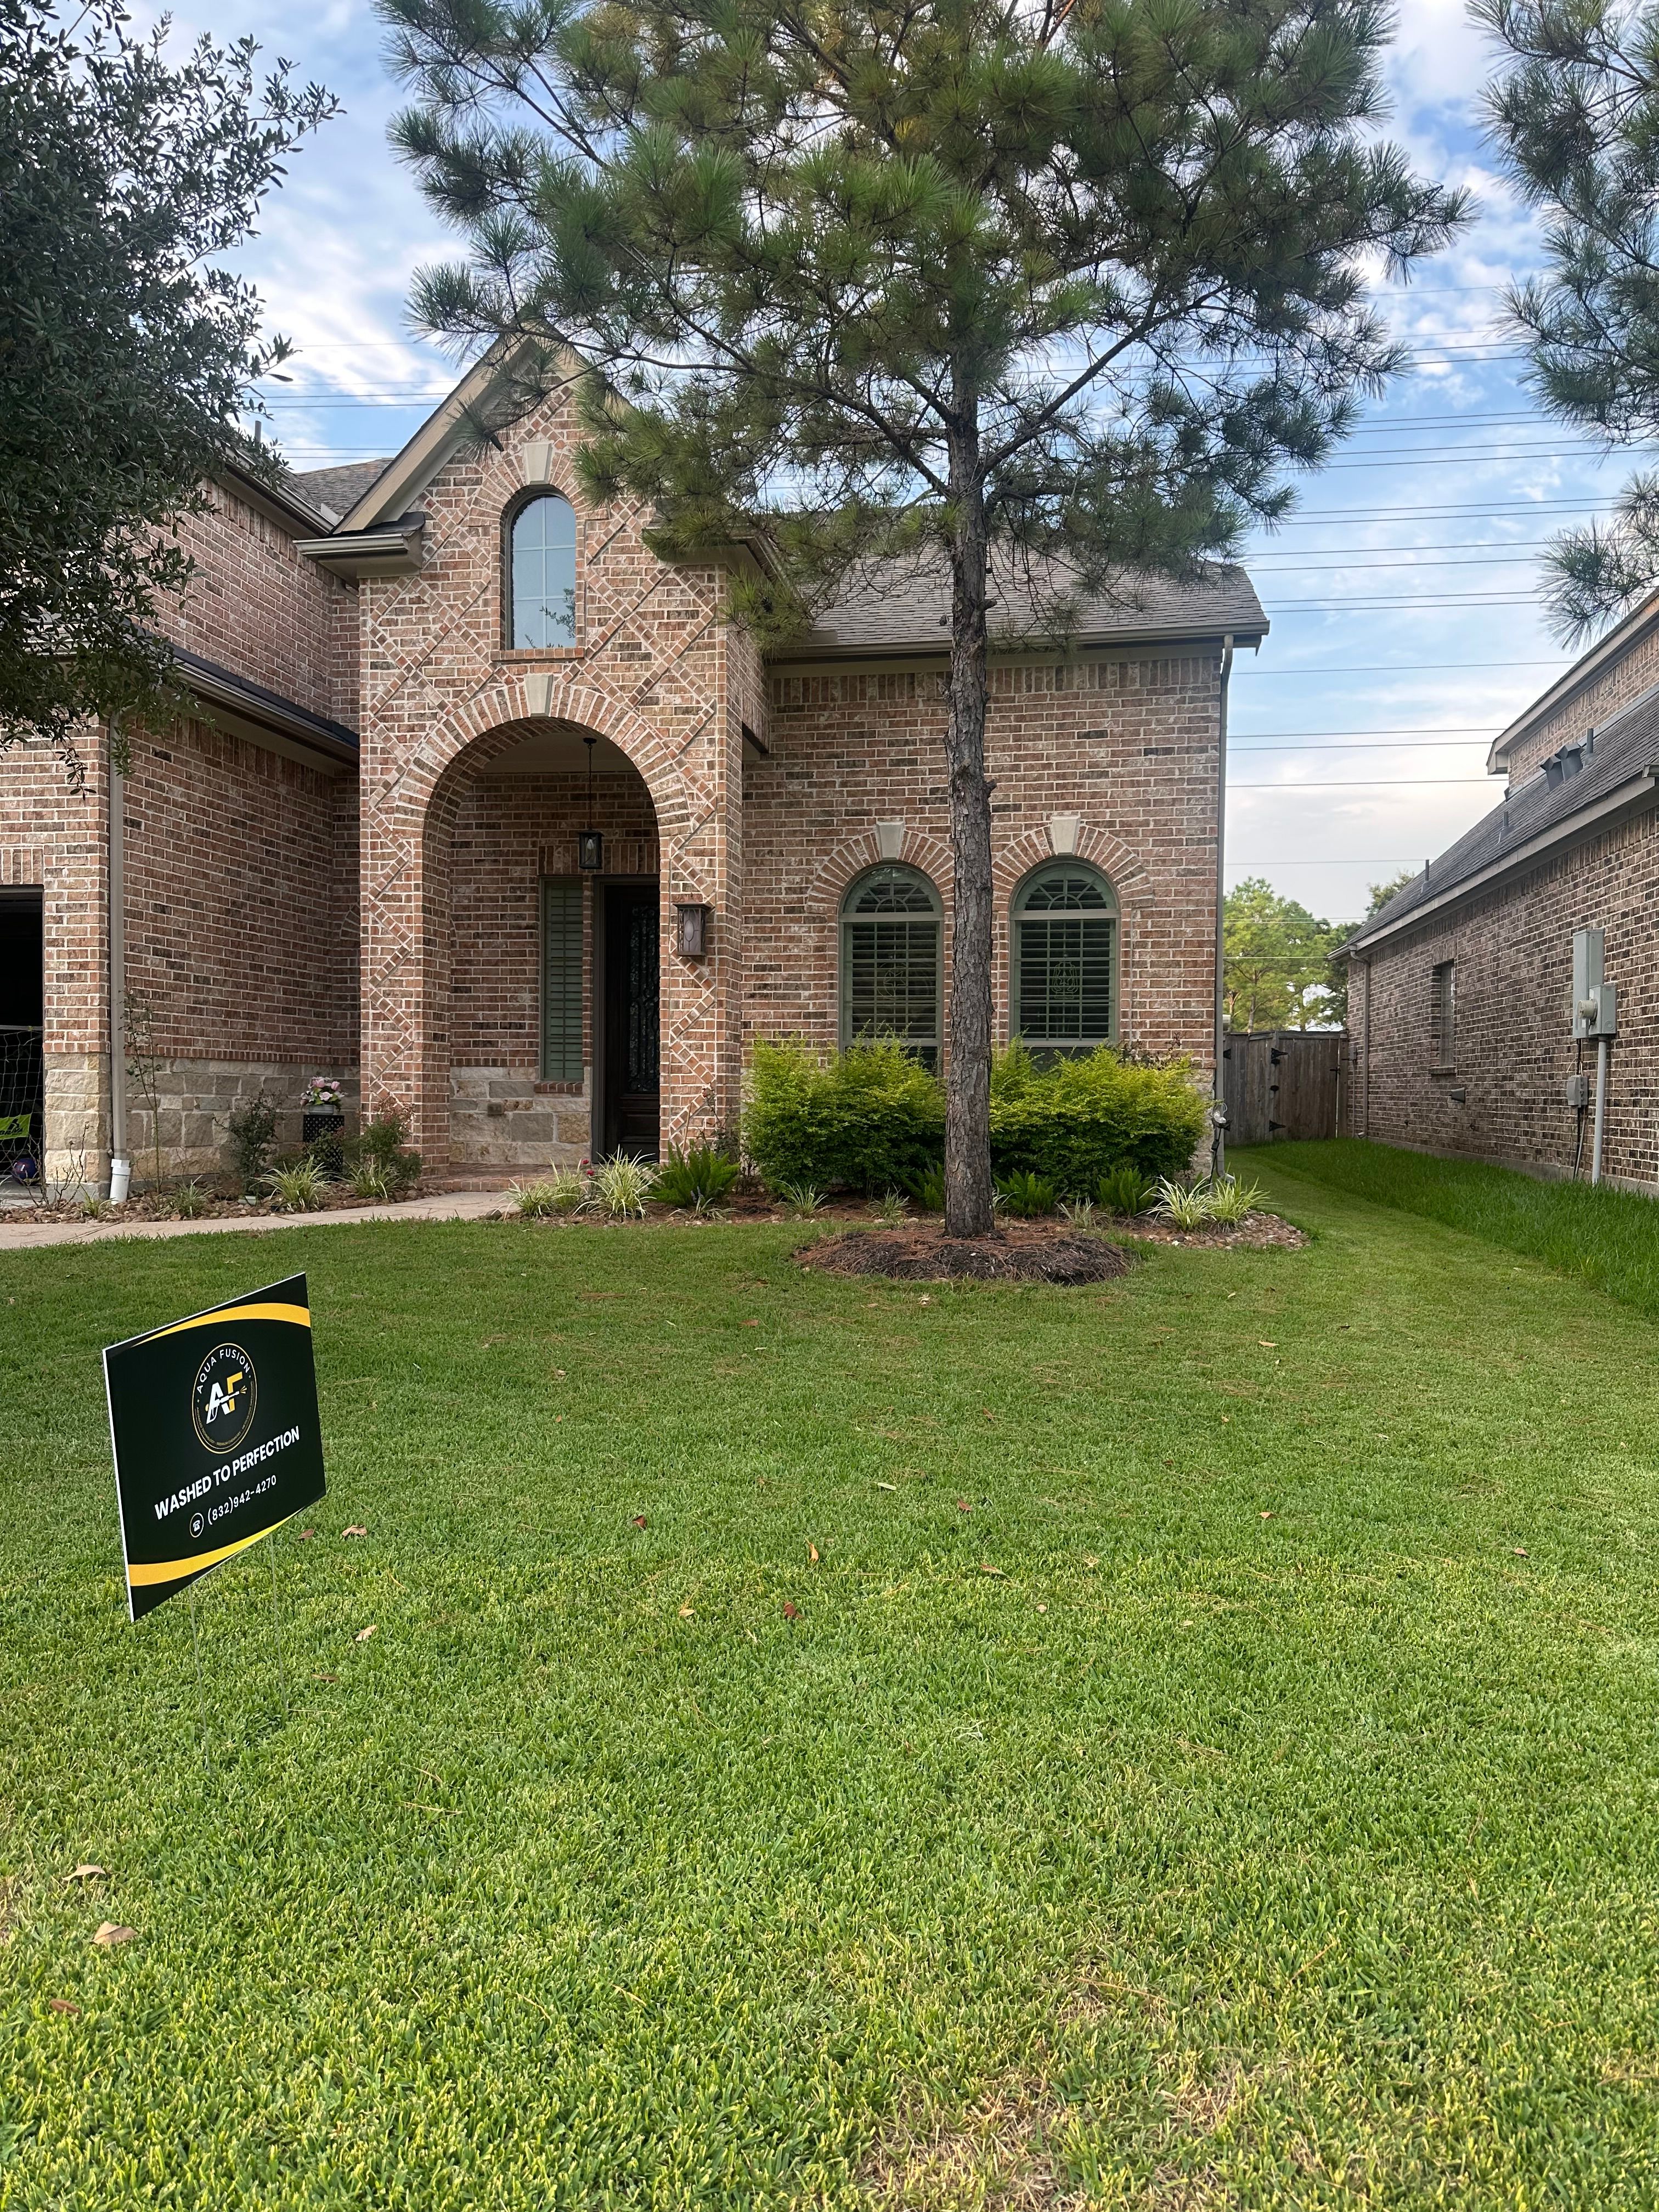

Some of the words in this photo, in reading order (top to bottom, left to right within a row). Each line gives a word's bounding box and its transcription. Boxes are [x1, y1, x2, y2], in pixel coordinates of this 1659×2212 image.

[196, 1356, 217, 1394] AQUA
[219, 1348, 250, 1373] FUSION
[154, 1476, 212, 1520] WASHED
[213, 1465, 230, 1486] TO
[232, 1425, 300, 1476] PERFECTION
[207, 1475, 276, 1525] (832)942-4270
